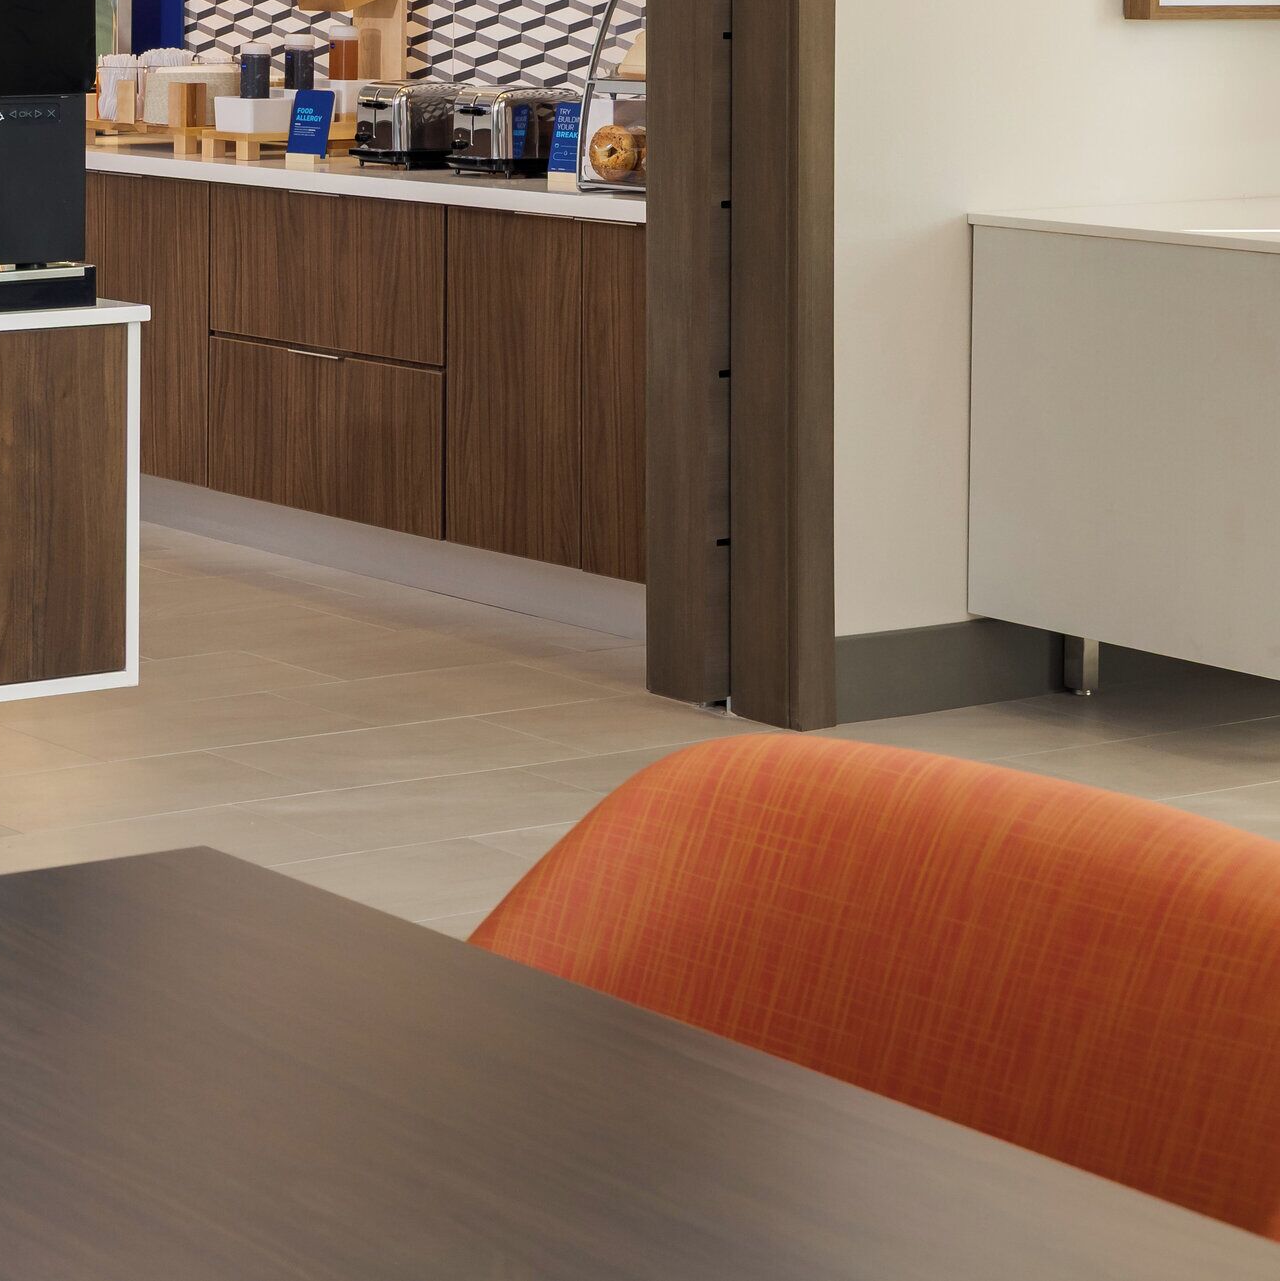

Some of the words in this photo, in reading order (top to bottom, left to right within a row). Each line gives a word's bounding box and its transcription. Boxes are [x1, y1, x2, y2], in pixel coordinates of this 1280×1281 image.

[295, 114, 323, 122] ALLERGY
[557, 123, 575, 131] YOUR
[555, 131, 578, 139] BREAK
